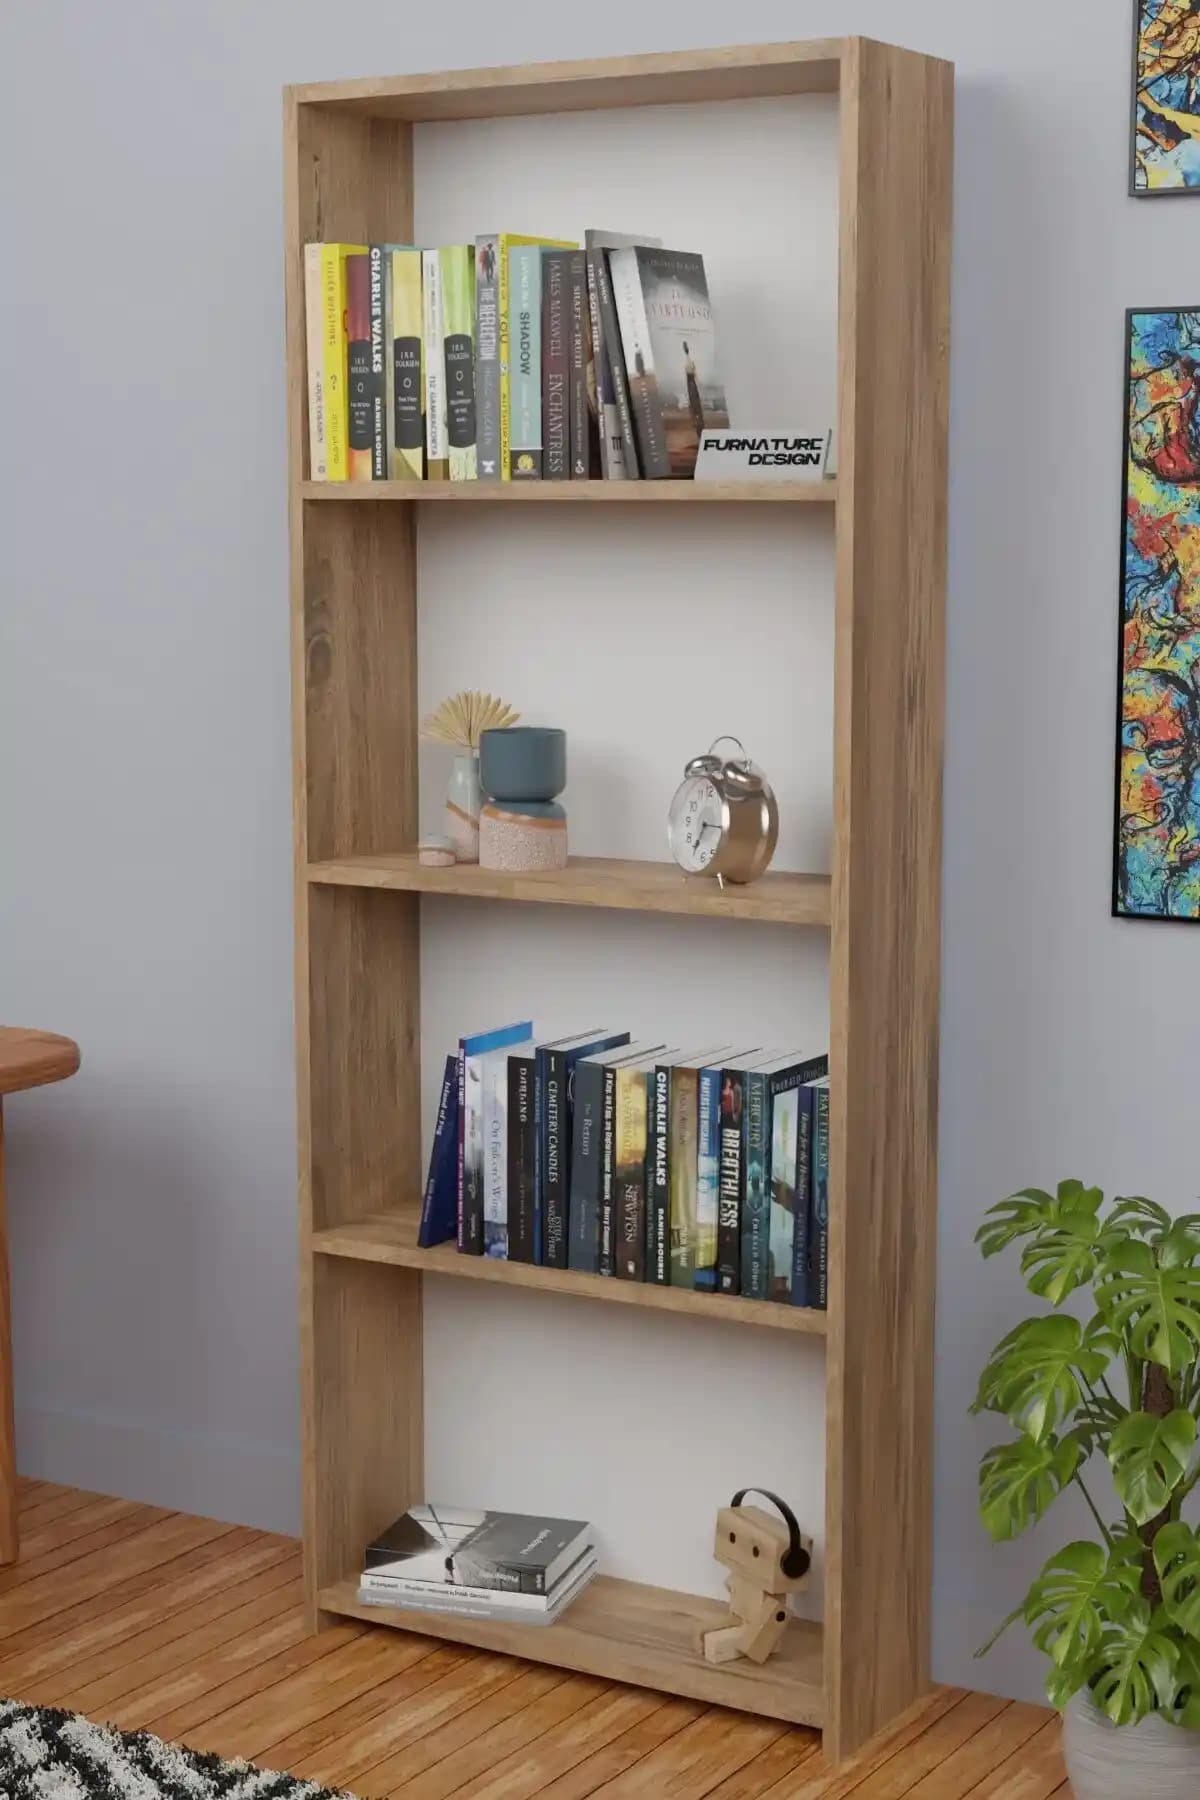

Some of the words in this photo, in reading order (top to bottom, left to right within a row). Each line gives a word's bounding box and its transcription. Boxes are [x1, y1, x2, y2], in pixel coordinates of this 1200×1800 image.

[371, 247, 381, 316] CHARLIE
[482, 287, 495, 301] THE
[548, 260, 561, 297] JAMES
[480, 303, 496, 361] REFLECTION
[499, 310, 509, 345] YOU
[549, 299, 563, 357] MAXWELL
[587, 263, 595, 289] TITLE
[592, 325, 601, 353] HERE
[372, 318, 383, 374] WALKS
[519, 311, 531, 376] SHADOW
[574, 332, 583, 369] TRUTH
[548, 373, 564, 473] ENCHANTRESS
[703, 438, 824, 451] FURNATURE
[748, 452, 820, 466] DESIGN
[440, 1081, 452, 1108] Island
[548, 1080, 559, 1134] CEMETERY
[656, 1071, 667, 1135] CHARLIE
[750, 1081, 763, 1152] MERCURY
[491, 1119, 501, 1138] On
[582, 1117, 593, 1156] Return
[491, 1140, 502, 1184] Falcon's
[548, 1135, 559, 1184] CANDLES
[656, 1136, 668, 1186] WALKS
[720, 1127, 741, 1228] BREATHLESS
[624, 1183, 638, 1243] NEWTON
[657, 1207, 665, 1242] DANIEL
[819, 1273, 827, 1304] DODGE
